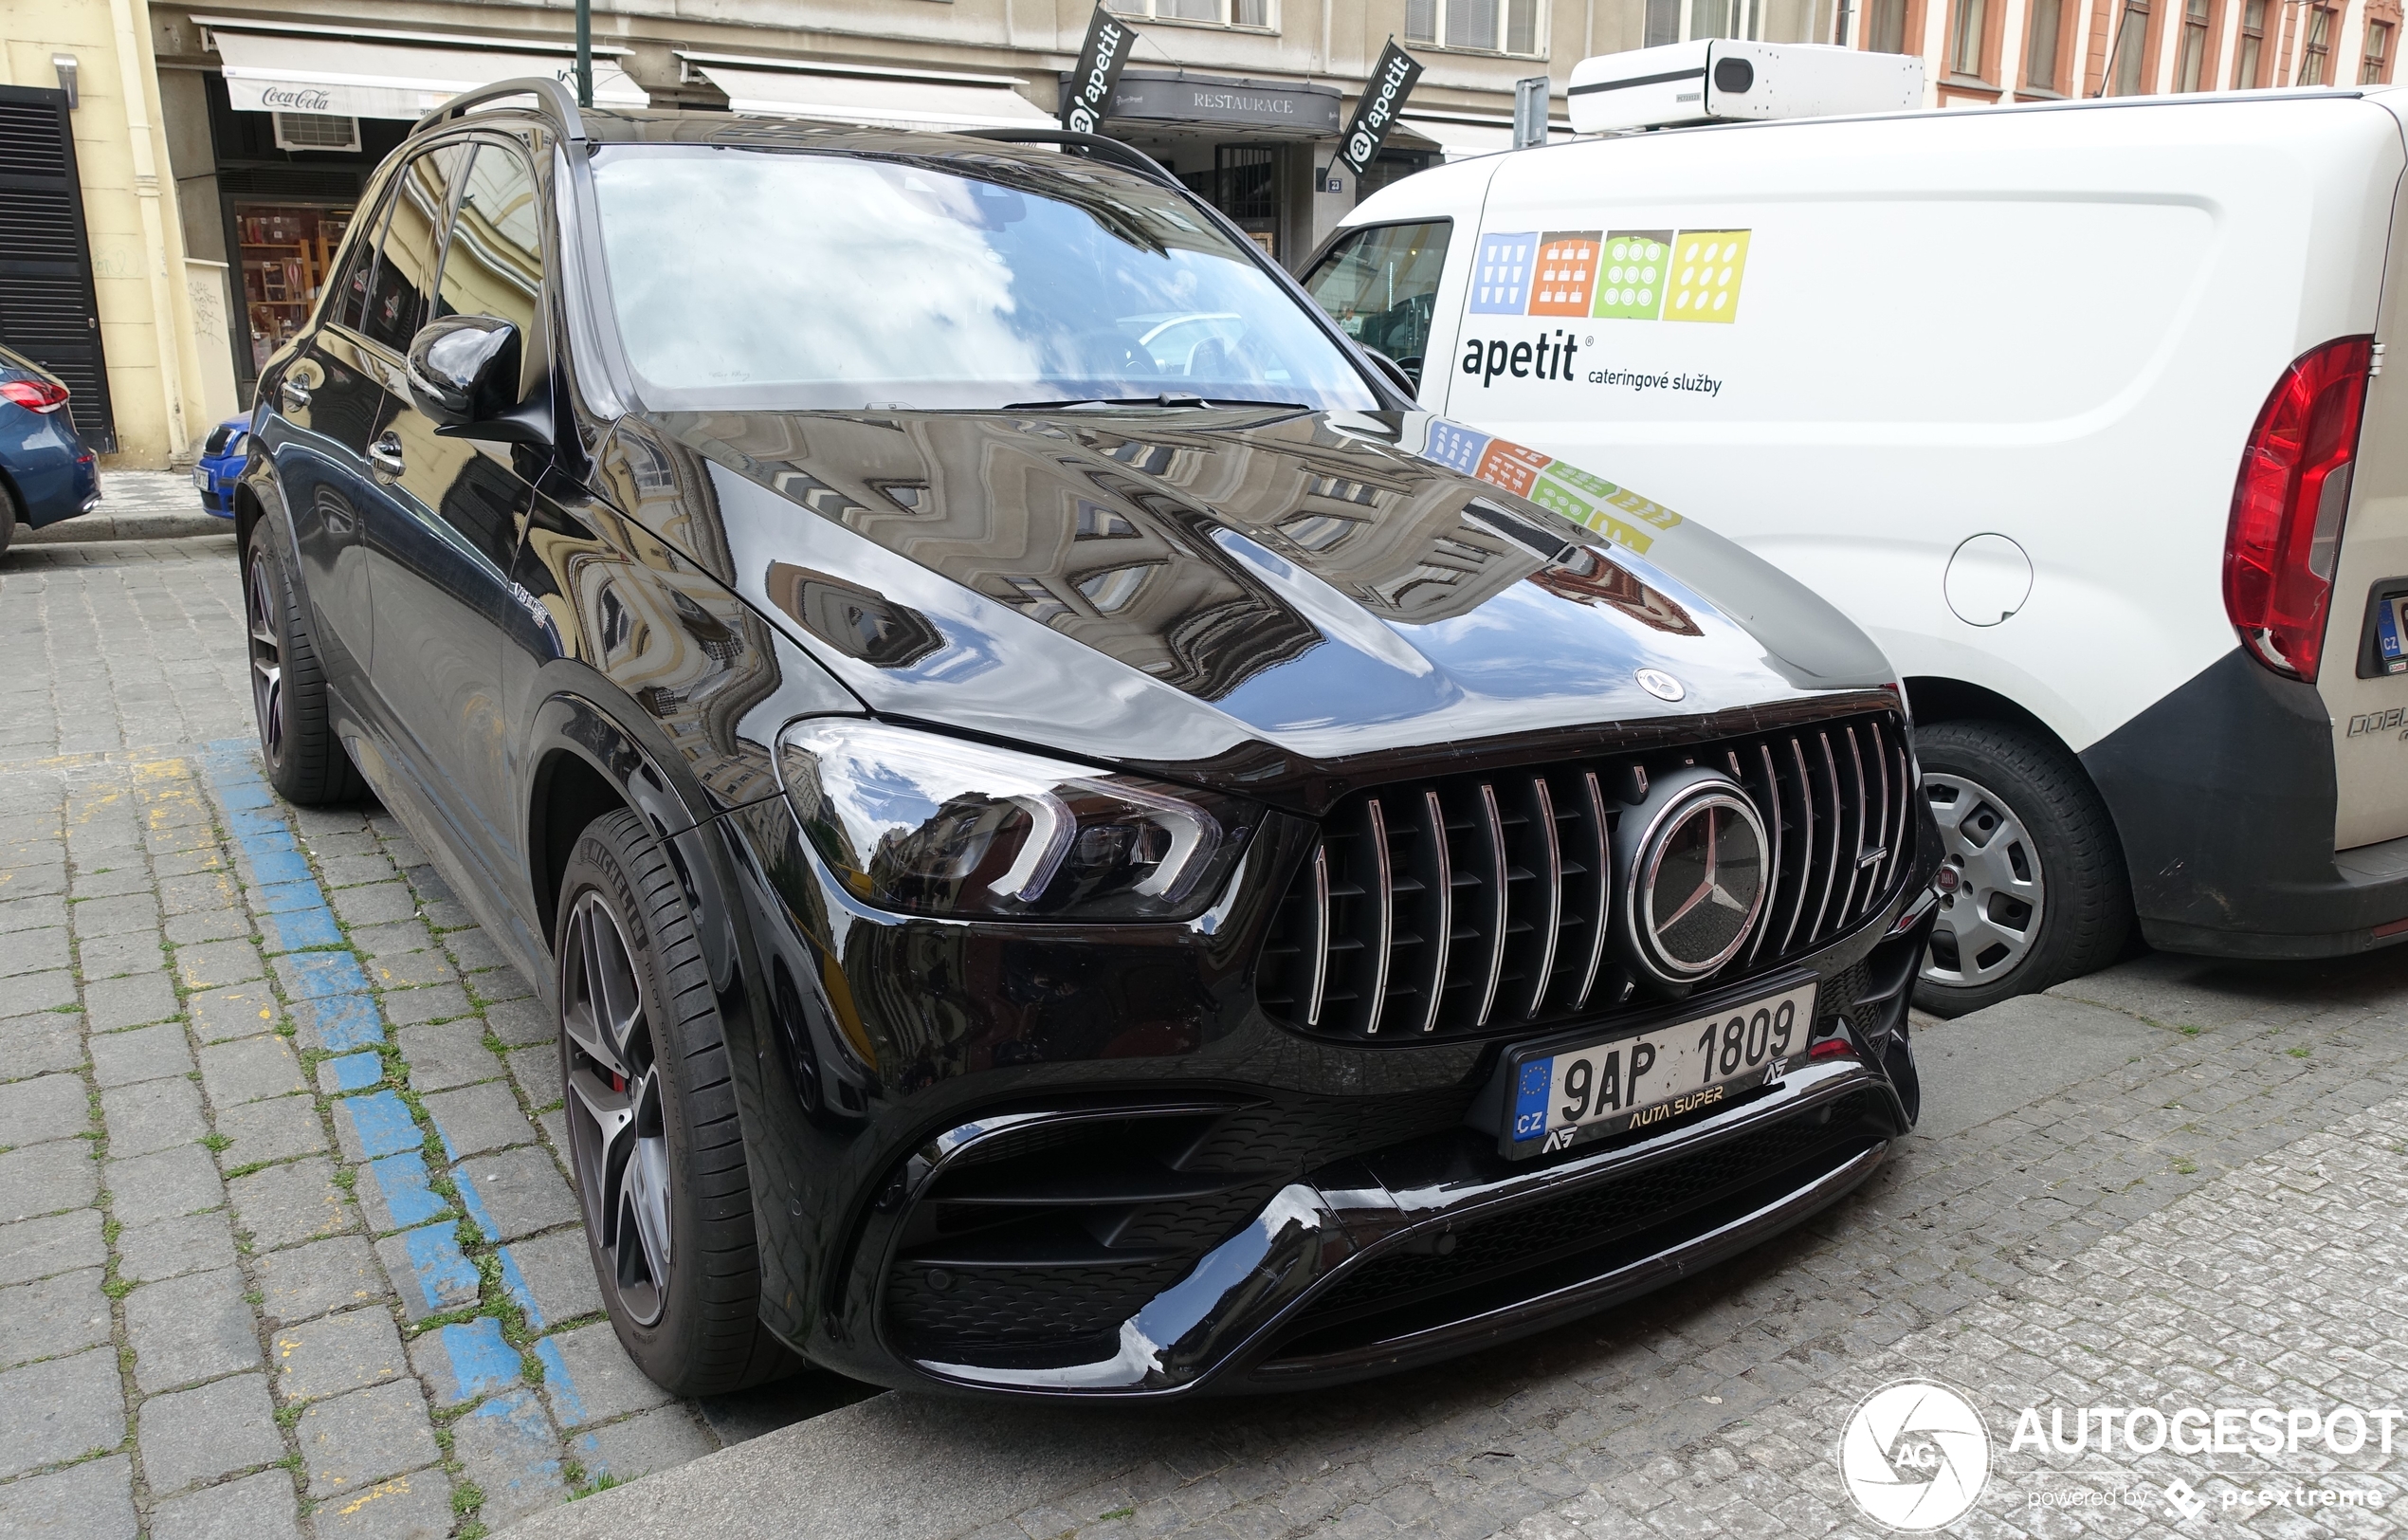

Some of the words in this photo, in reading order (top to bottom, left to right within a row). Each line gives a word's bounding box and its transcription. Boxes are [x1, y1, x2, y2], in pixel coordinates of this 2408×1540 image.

[1085, 23, 1122, 103] apetit
[262, 86, 330, 110] Coca-Cola
[1194, 92, 1293, 115] RESTAURACE
[1368, 56, 1410, 128] apetit
[1331, 181, 1340, 191] 23
[1462, 329, 1578, 388] apetit
[1588, 368, 1669, 390] cateringové
[1671, 372, 1723, 397] služby
[2383, 636, 2398, 651] CZ
[590, 841, 645, 942] MICHELIN
[646, 961, 662, 1009] PILOT
[660, 1021, 675, 1085] SPORT
[1561, 1042, 1655, 1122] 9AP
[1697, 999, 1796, 1083] 1809
[1517, 1112, 1541, 1134] CZ
[1629, 1104, 1669, 1129] AUTA
[1674, 1086, 1724, 1115] SUPER
